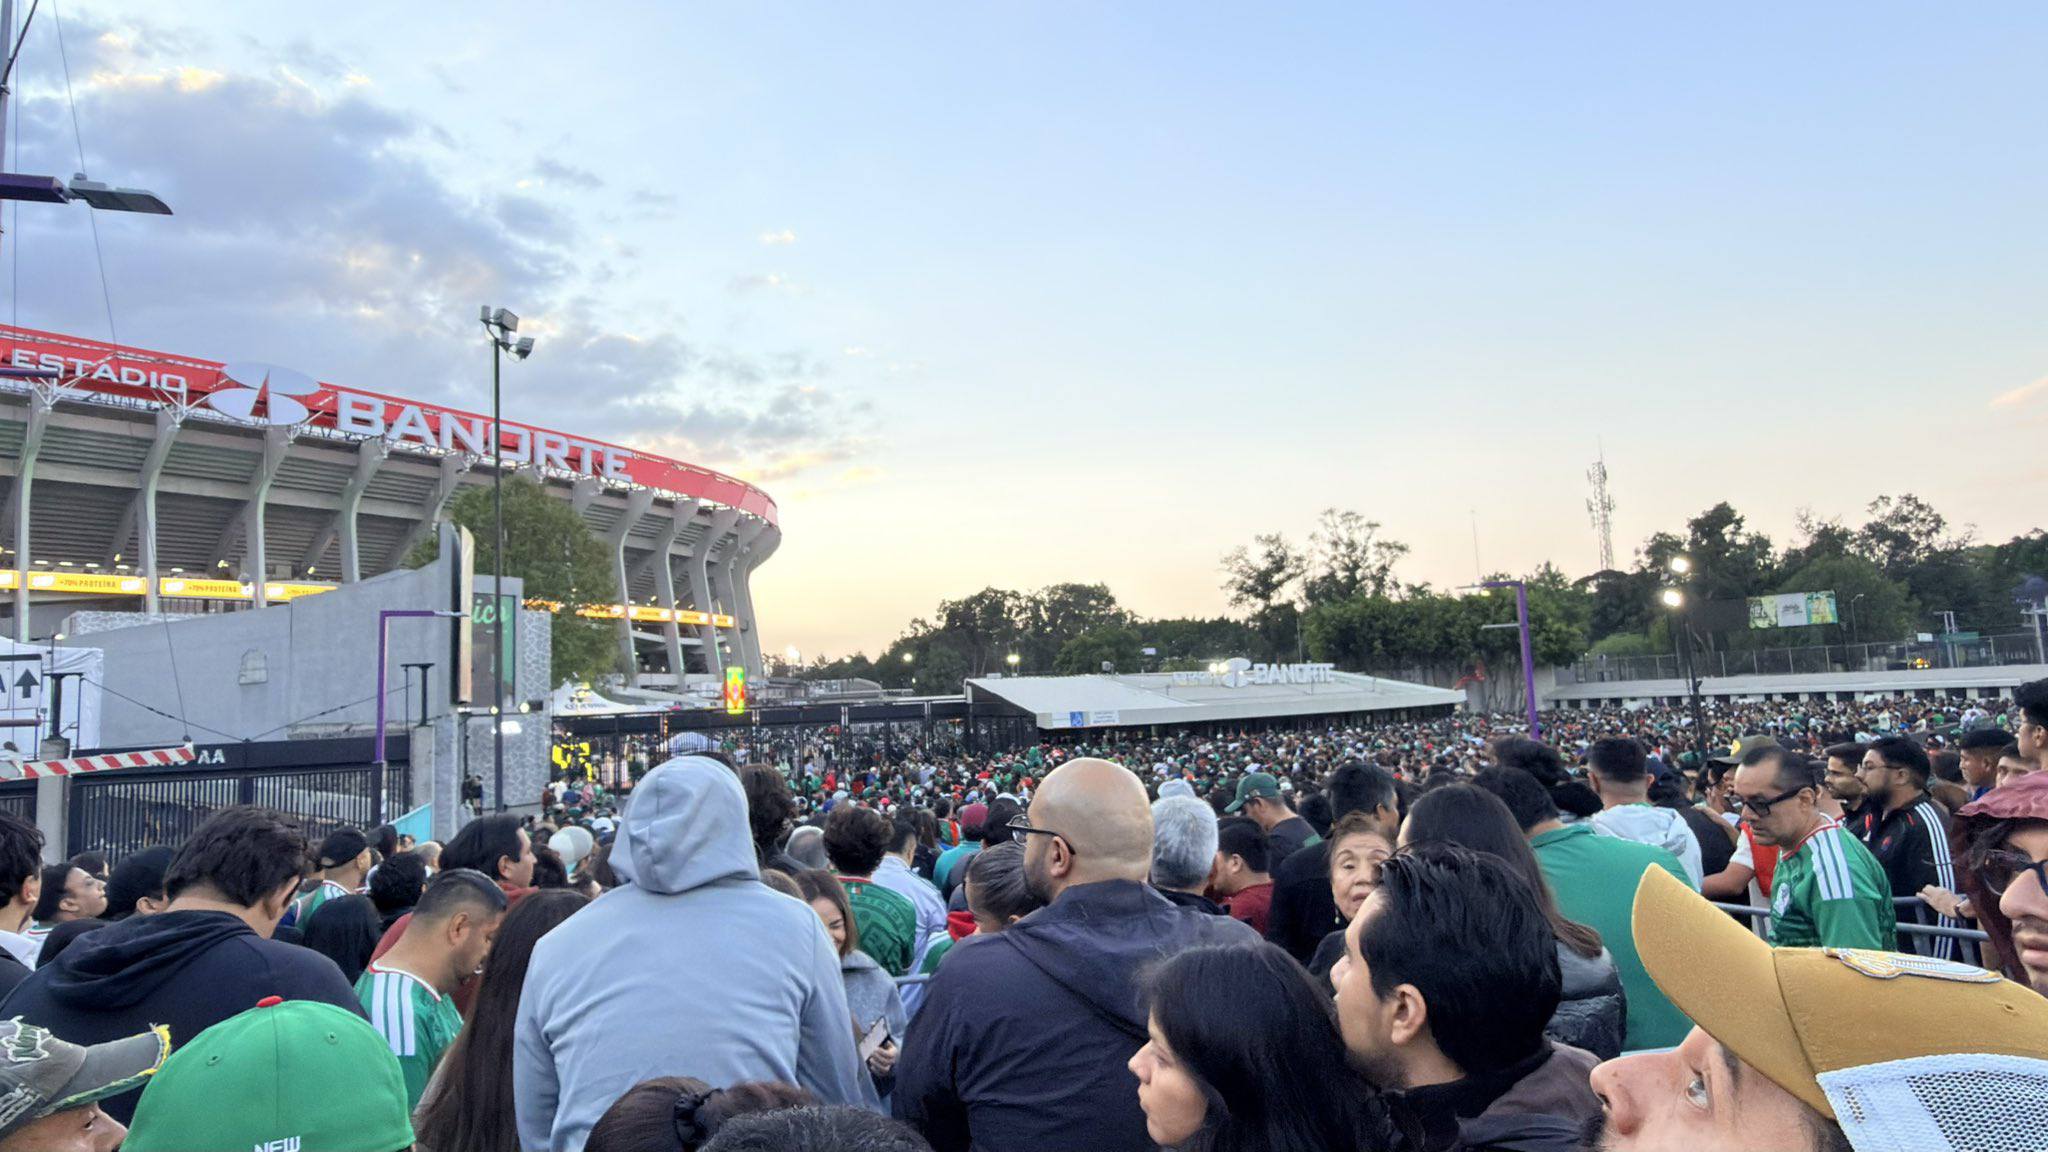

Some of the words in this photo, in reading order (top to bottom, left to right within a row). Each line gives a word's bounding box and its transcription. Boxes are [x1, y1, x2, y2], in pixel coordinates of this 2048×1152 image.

[11, 348, 187, 393] ESTADIO
[336, 393, 634, 482] BANORTE
[1253, 662, 1335, 684] BANORTE
[254, 1136, 301, 1152] NEW
